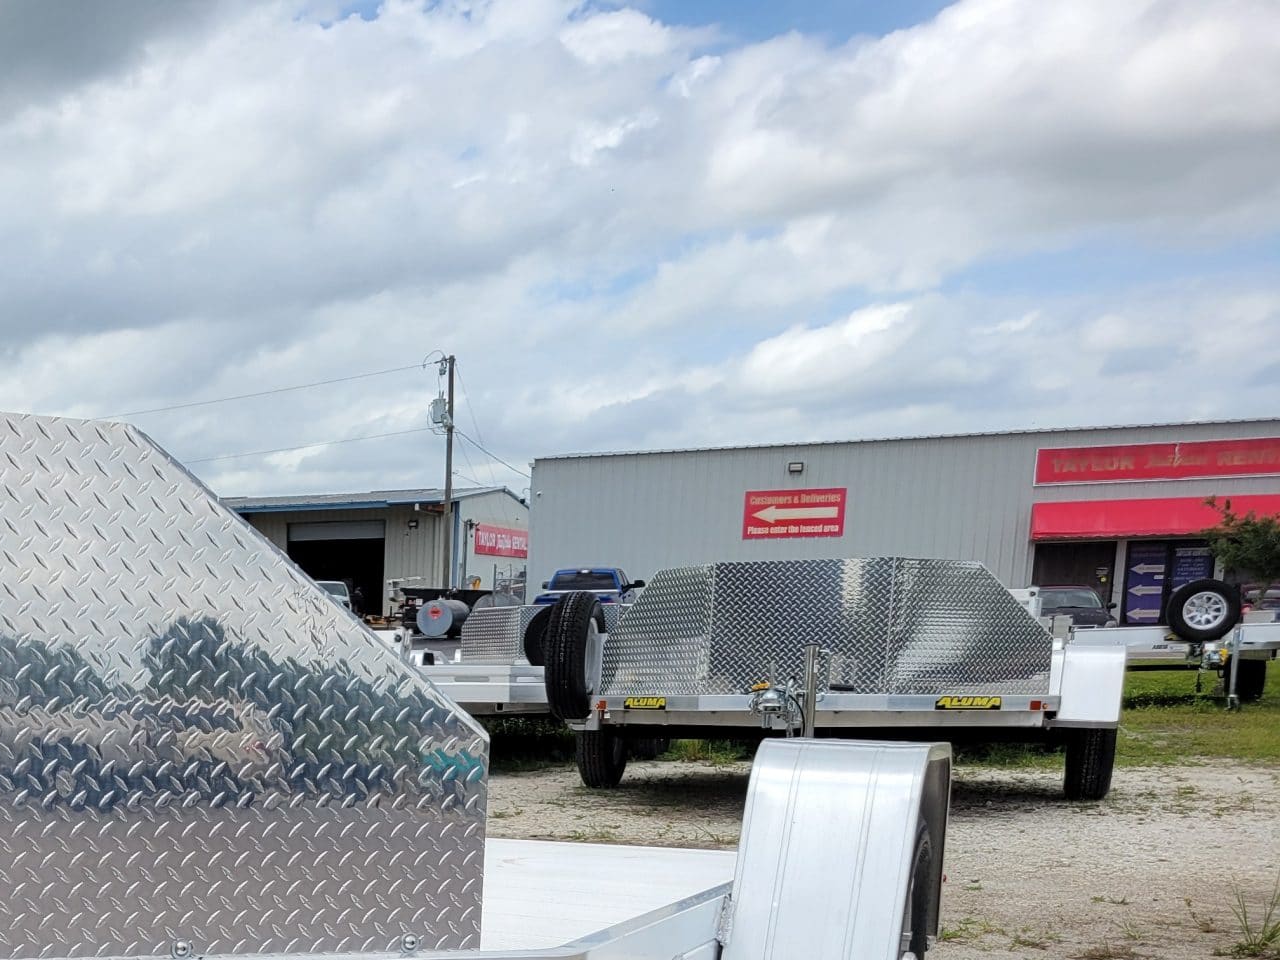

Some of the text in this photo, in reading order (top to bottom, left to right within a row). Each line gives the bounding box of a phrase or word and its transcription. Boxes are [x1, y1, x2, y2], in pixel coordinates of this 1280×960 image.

[747, 526, 769, 535] Please
[624, 696, 666, 708] ALUMA
[936, 696, 1001, 709] ALUMA
